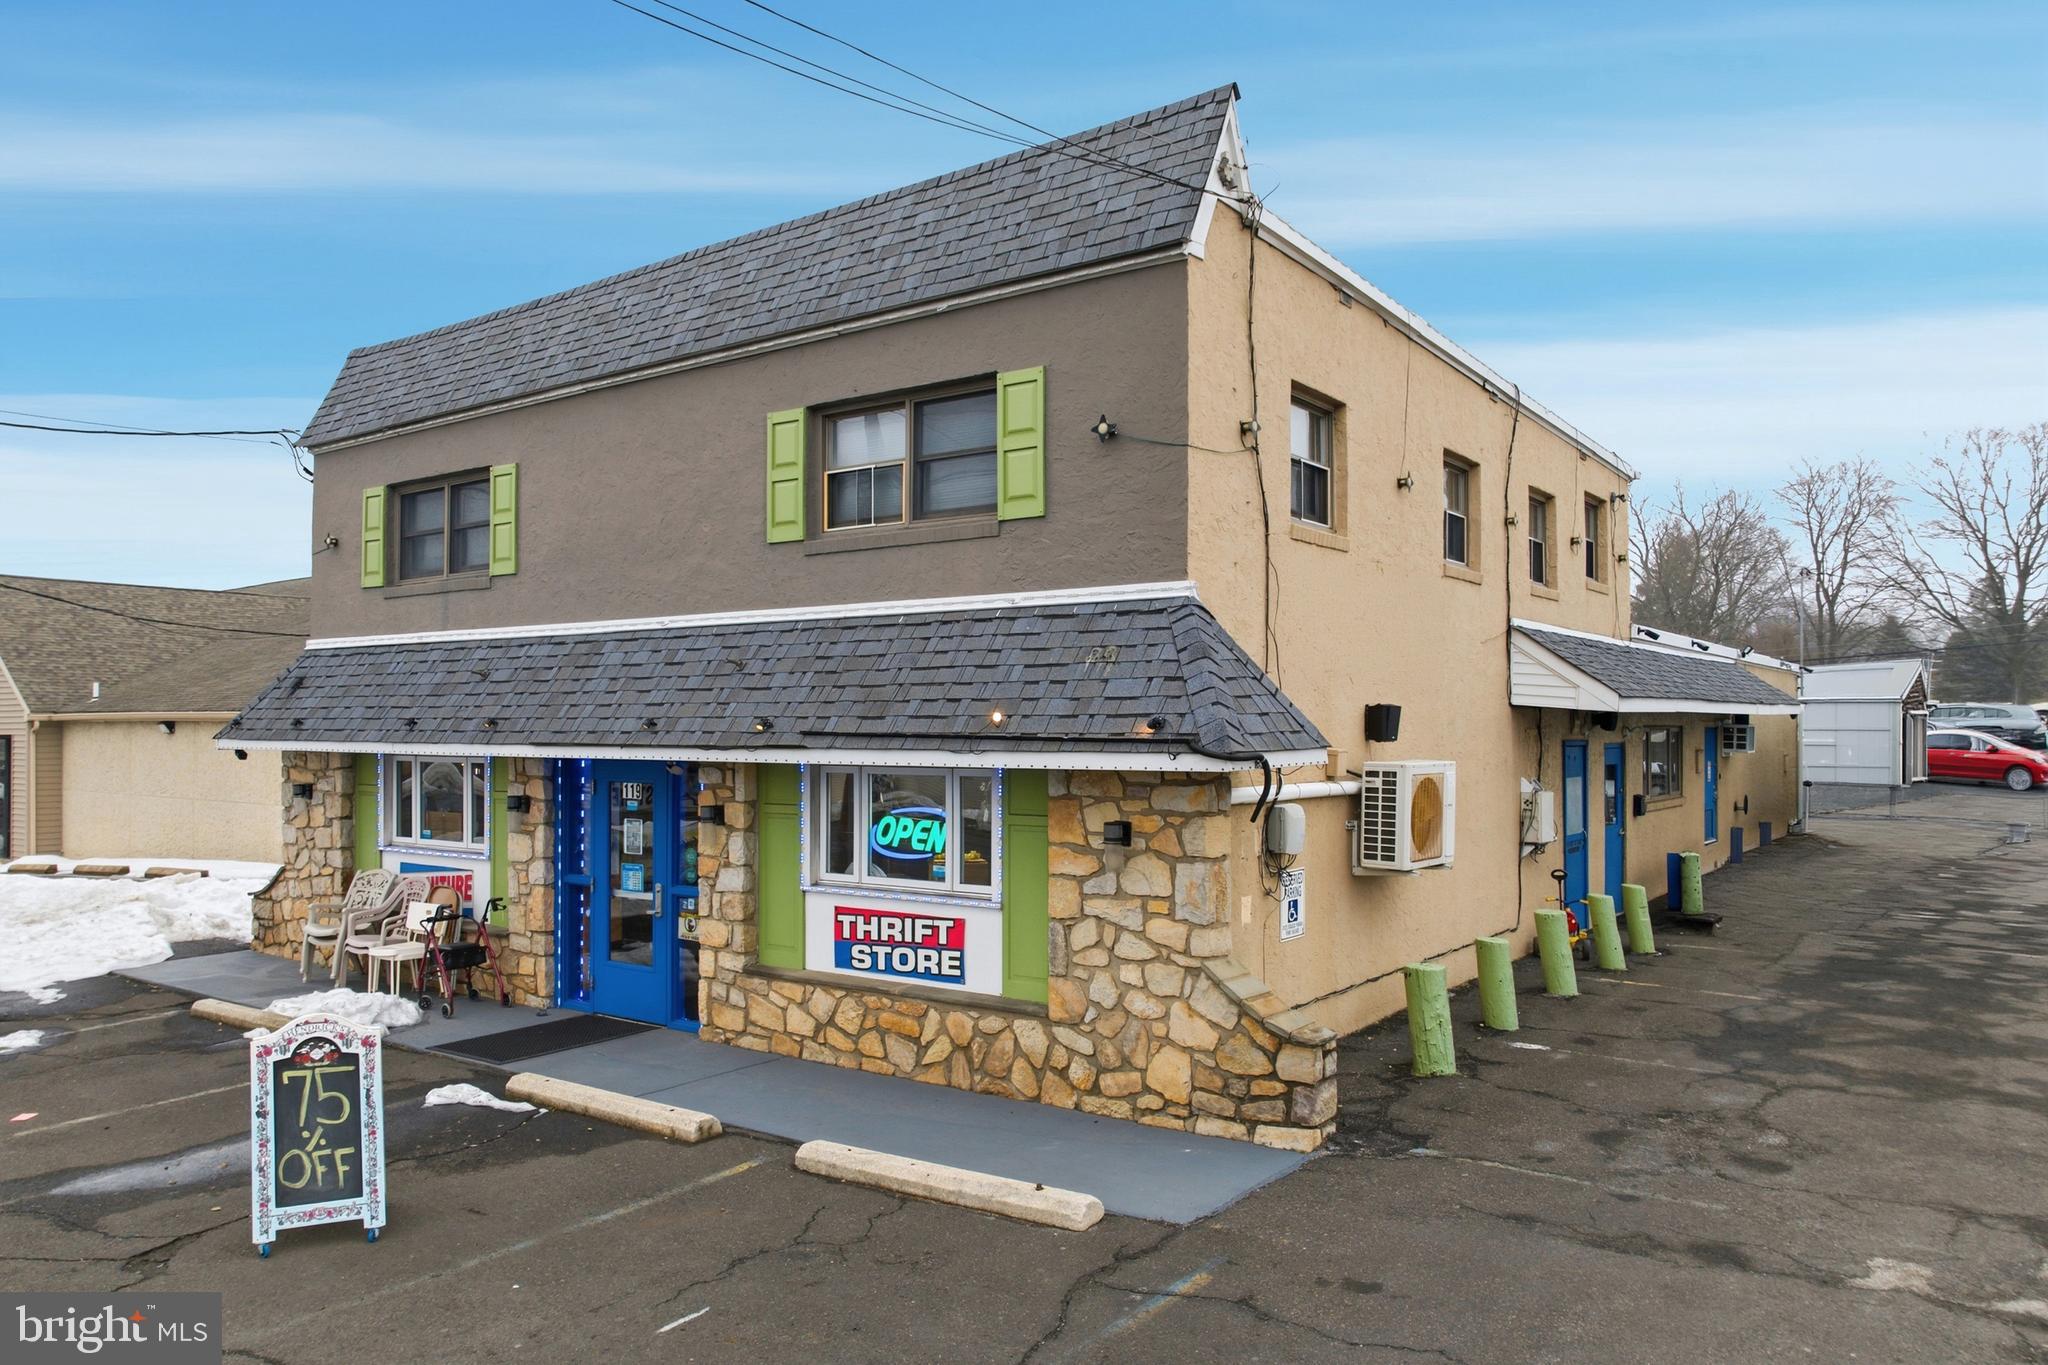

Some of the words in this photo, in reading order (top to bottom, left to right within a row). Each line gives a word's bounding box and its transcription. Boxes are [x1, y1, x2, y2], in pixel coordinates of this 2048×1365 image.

[624, 783, 641, 799] 119
[875, 815, 946, 854] OPEN
[836, 913, 954, 946] THRIFT
[850, 943, 962, 977] STORE
[281, 1065, 356, 1128] 75
[301, 1125, 326, 1152] %
[278, 1146, 355, 1189] OFF
